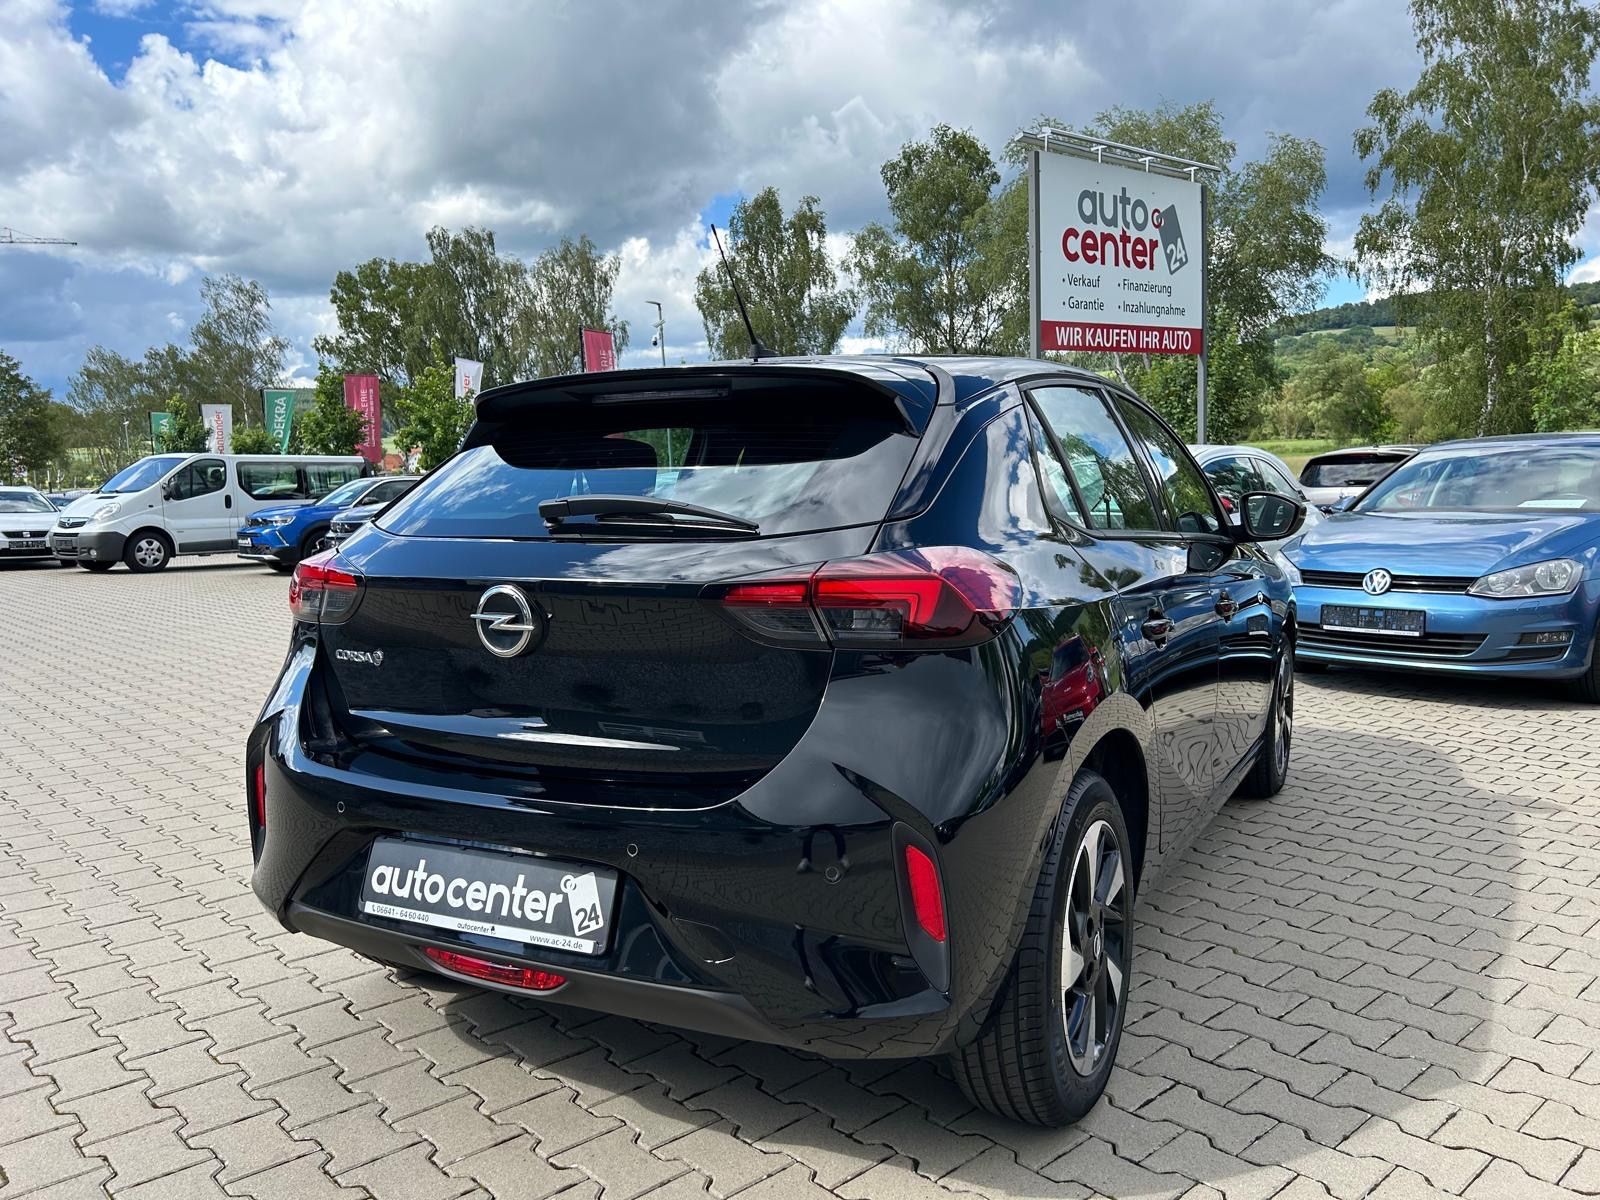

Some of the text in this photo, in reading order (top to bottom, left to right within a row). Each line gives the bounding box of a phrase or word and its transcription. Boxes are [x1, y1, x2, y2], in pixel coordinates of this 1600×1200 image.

[1077, 187, 1149, 232] auto
[1062, 227, 1159, 270] center
[1166, 237, 1186, 271] 24
[1067, 273, 1101, 289] Verkauf
[1122, 279, 1172, 296] Finanzierung
[1068, 296, 1105, 311] Garantie
[1123, 300, 1186, 317] Inzahlungnahme
[1056, 326, 1191, 350] WIR KAUFEN IHR AUTO
[273, 396, 288, 438] DEKRA
[371, 859, 563, 924] autocenter
[575, 902, 600, 932] 24
[529, 934, 584, 950] www.ac-24.de
